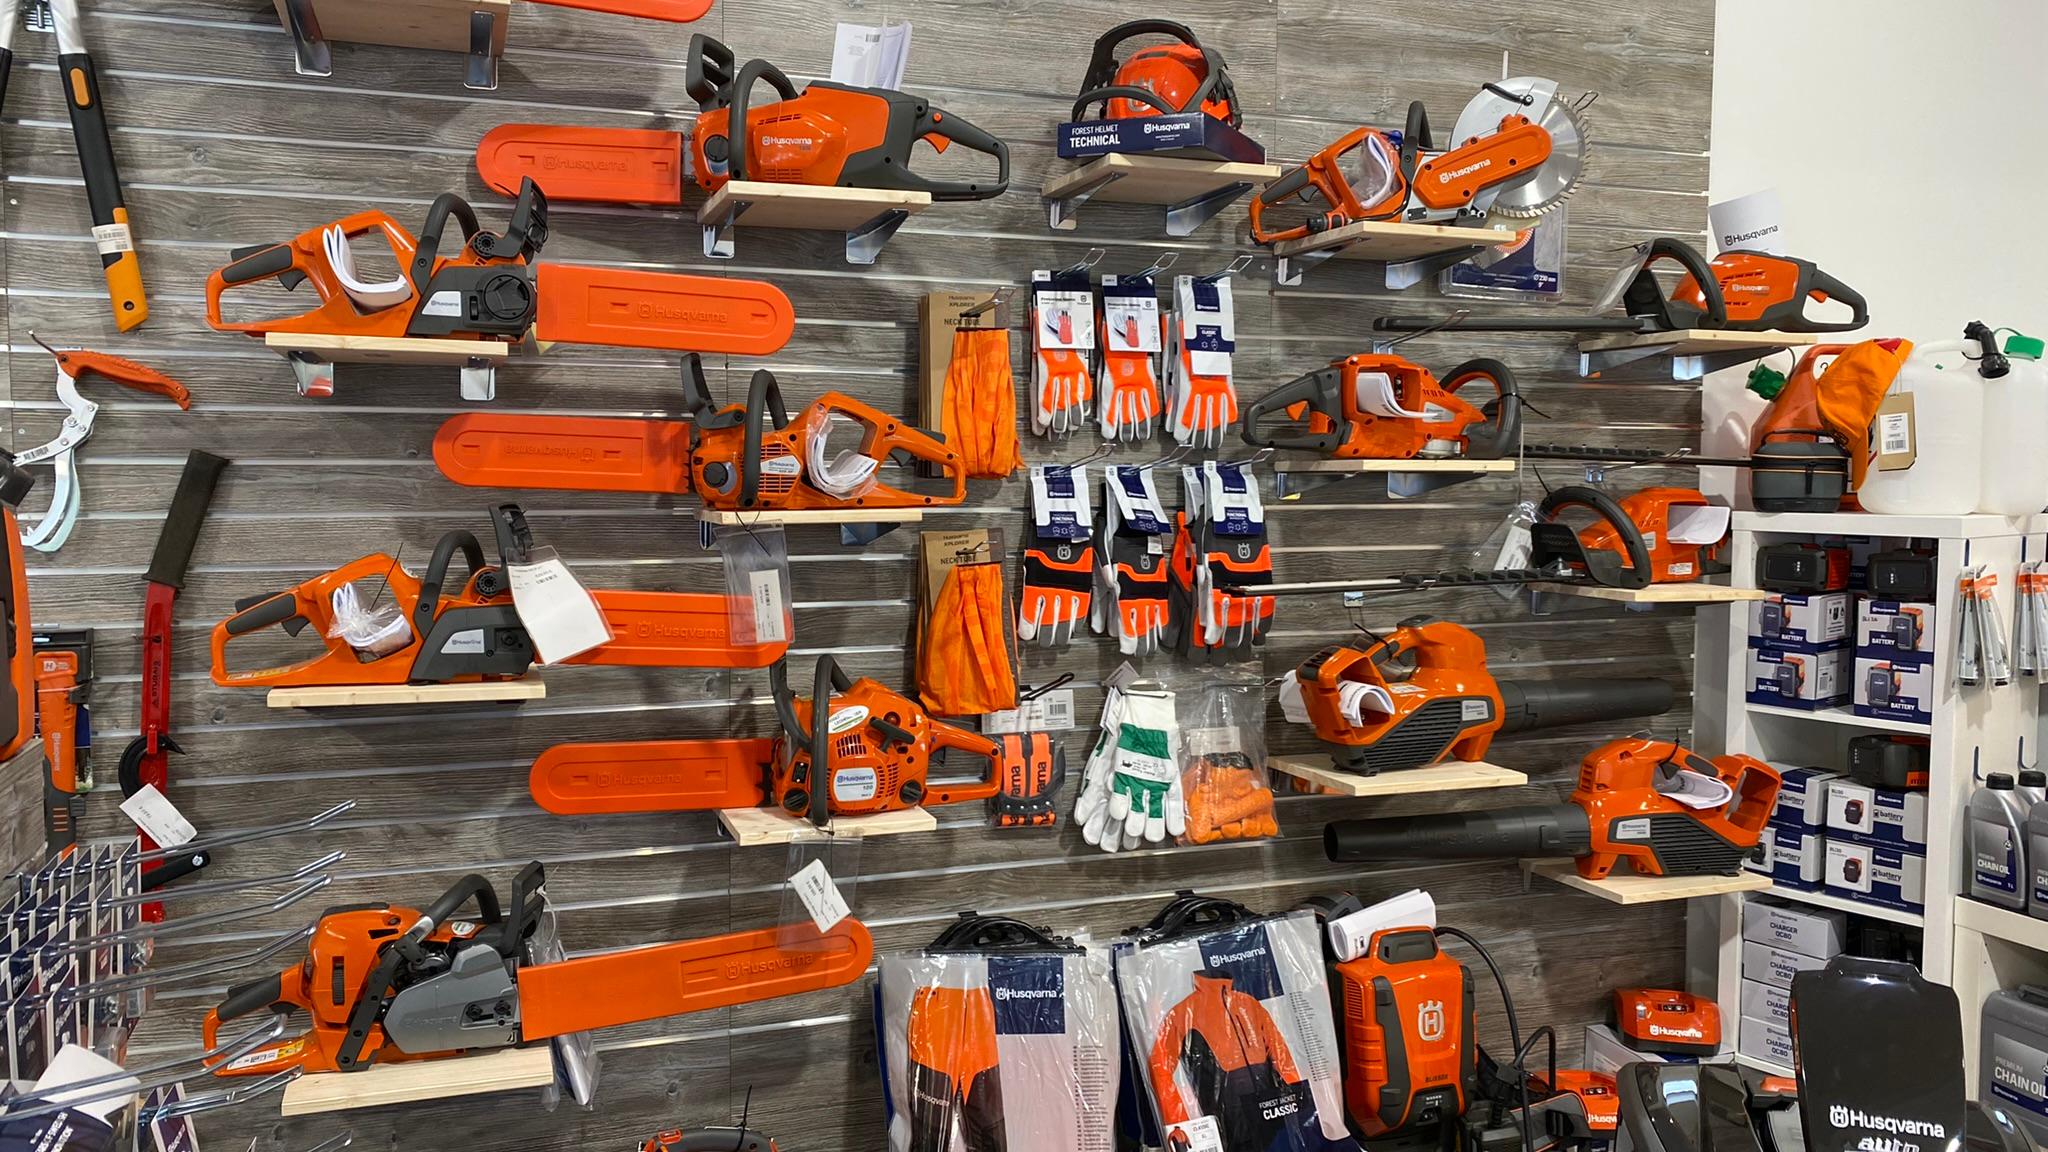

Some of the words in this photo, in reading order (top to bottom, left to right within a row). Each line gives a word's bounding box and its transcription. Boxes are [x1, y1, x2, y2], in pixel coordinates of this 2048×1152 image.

[1072, 125, 1093, 135] FOREST
[1094, 124, 1118, 133] HELMET
[1152, 122, 1191, 133] Husqvarna
[770, 136, 812, 145] Husqvarna
[1070, 134, 1120, 148] TECHNICAL
[1448, 158, 1492, 180] Husqvarna
[1733, 224, 1779, 243] Husqvarna
[655, 305, 728, 323] Husqvarna
[940, 556, 958, 565] NECK
[653, 622, 727, 640] Husqvarna
[1781, 634, 1803, 642] BATTERY
[1871, 637, 1895, 646] BATTERY
[1758, 684, 1780, 693] BATTERY
[1890, 702, 1915, 711] BATTERY
[614, 772, 682, 786] Husqvarna
[843, 774, 874, 782] Husqvarna
[1784, 794, 1805, 806] battery
[1879, 810, 1904, 823] battery
[1779, 850, 1801, 862] battery
[1977, 859, 1999, 872] CHAIN
[1999, 864, 2010, 875] OIL
[1878, 869, 1902, 882] battery
[1770, 922, 1798, 934] CHARGER
[1775, 931, 1792, 940] QC80
[1220, 946, 1266, 964] Husqvarna
[741, 951, 814, 976] Husqvarna
[1770, 961, 1798, 974] CHARGER
[1775, 970, 1792, 980] QC80
[1007, 987, 1057, 1000] Husqvarna
[1766, 1000, 1789, 1011] CHARG
[1772, 1008, 1789, 1018] QC80
[1659, 1026, 1703, 1039] Husqvarna
[1771, 1047, 1788, 1057] QC80
[1995, 1055, 2024, 1073] PREMIUM
[1994, 1066, 2030, 1092] CHAIN
[2030, 1081, 2048, 1099] OIL
[1258, 1098, 1278, 1109] FOREST
[1279, 1093, 1297, 1104] JACKET
[1263, 1103, 1299, 1121] CLASSIC
[1591, 1114, 1618, 1125] Husqv
[1850, 1108, 1946, 1139] Husqvarna
